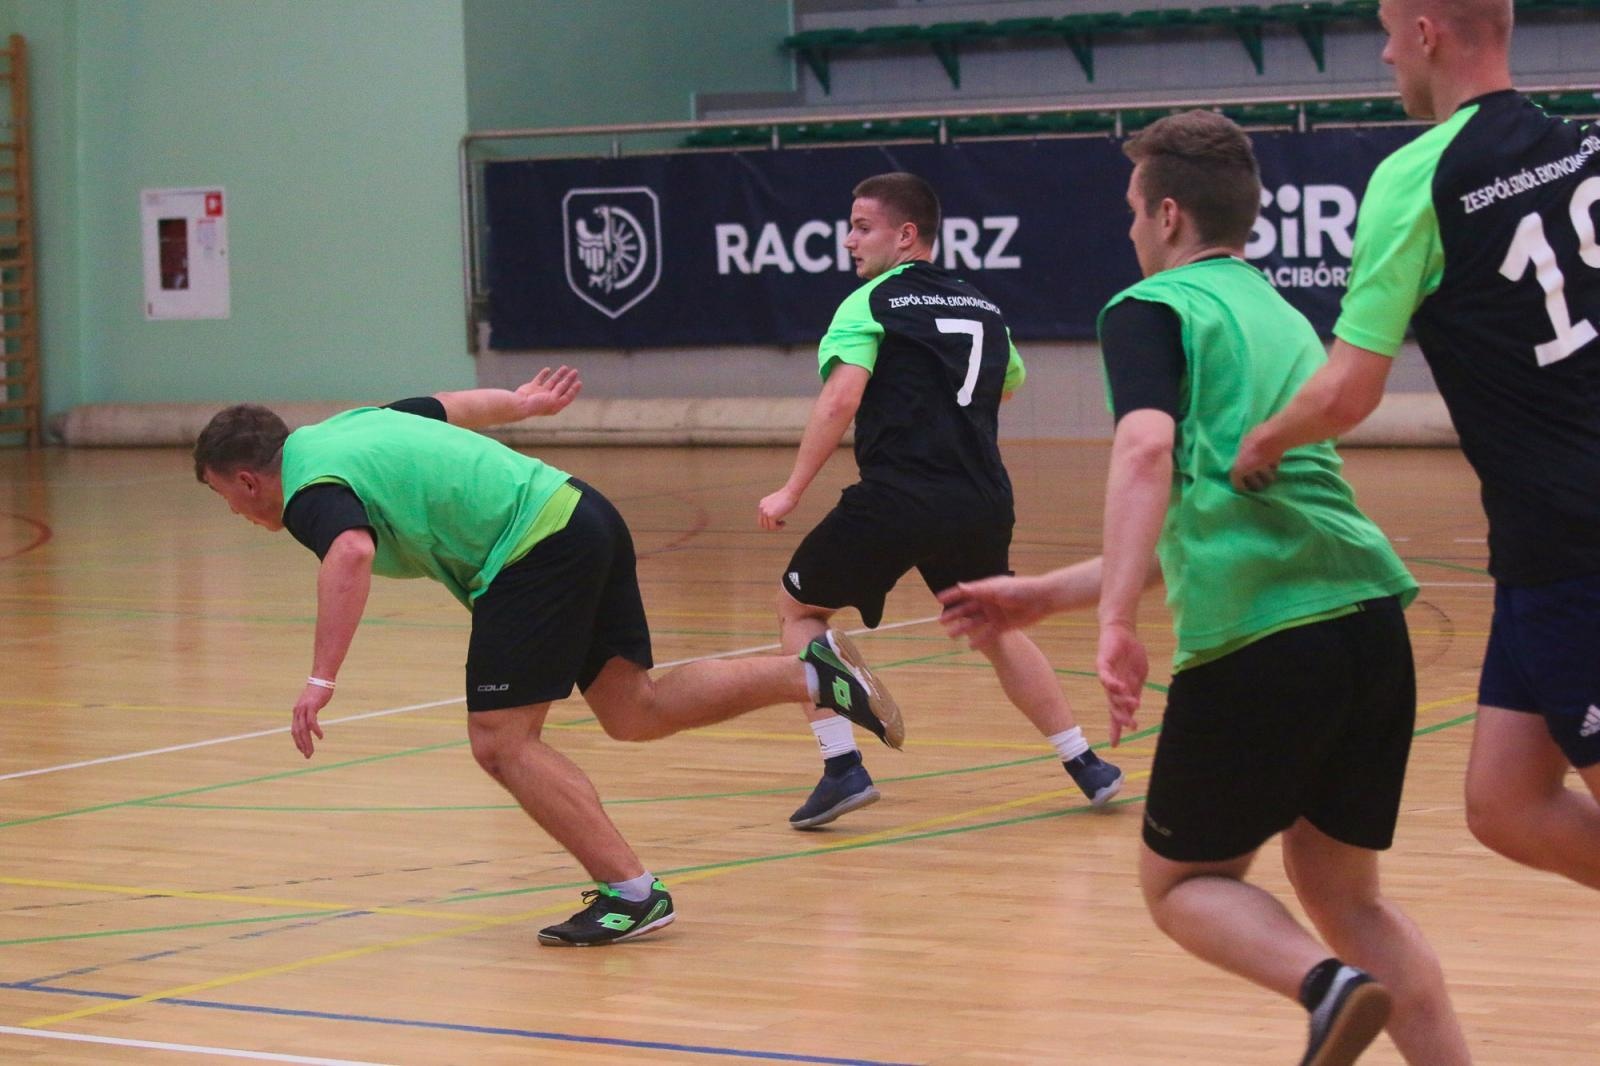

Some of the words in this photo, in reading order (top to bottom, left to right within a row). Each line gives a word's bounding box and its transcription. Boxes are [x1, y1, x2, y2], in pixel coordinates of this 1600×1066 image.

[715, 216, 1021, 275] RACIRZ
[888, 293, 923, 309] ZESPÓŁ
[921, 294, 948, 306] SZKÓŁ
[934, 318, 984, 407] 7
